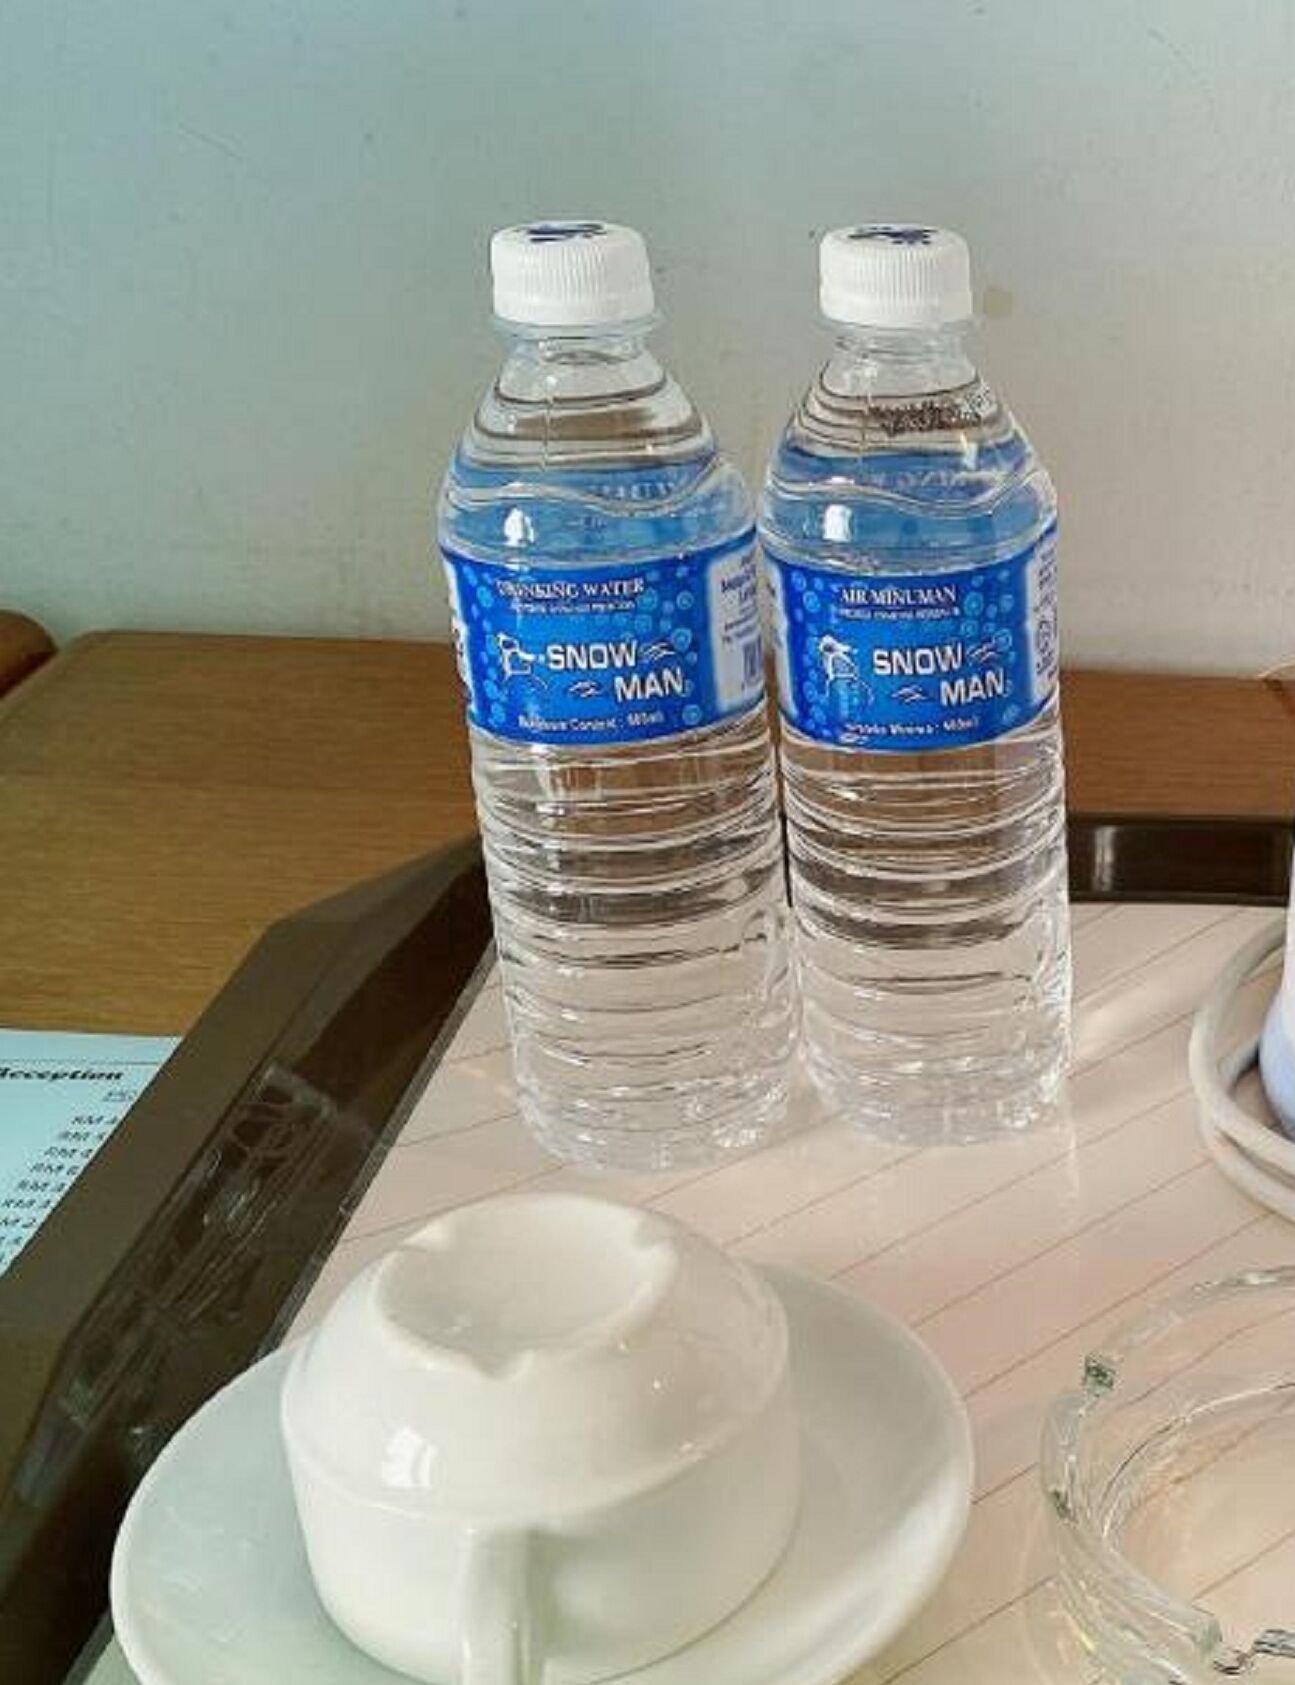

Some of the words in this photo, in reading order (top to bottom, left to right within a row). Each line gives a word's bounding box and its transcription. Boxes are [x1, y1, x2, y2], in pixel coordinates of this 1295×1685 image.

[583, 577, 645, 597] WATER
[841, 587, 868, 604] AIR
[546, 639, 638, 671] SNOW
[873, 642, 963, 676] SNOW
[613, 667, 685, 703] MAN
[939, 668, 1004, 707] MAN
